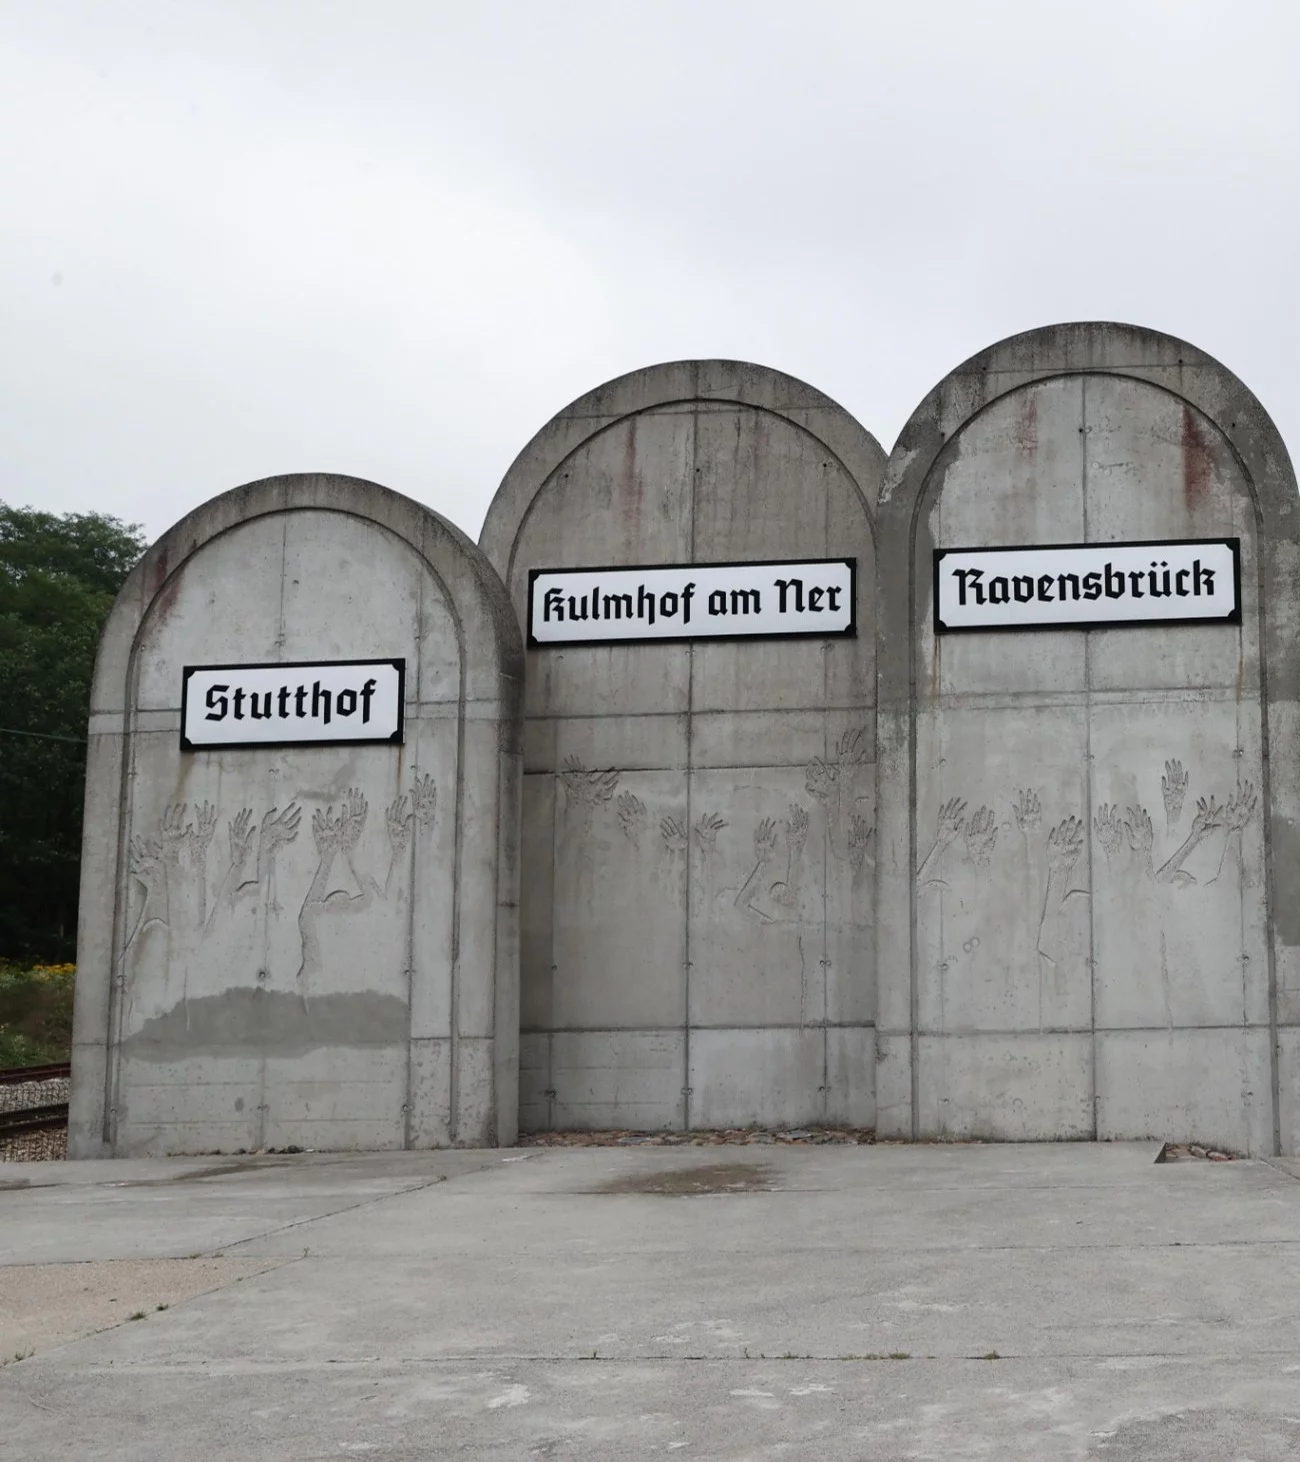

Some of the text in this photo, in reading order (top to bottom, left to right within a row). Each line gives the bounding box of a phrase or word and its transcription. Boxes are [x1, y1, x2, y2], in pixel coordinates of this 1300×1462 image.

[543, 578, 842, 626] Kulmhof am Ner
[951, 558, 1216, 606] Ravensbrück
[204, 678, 377, 725] Stutthof
